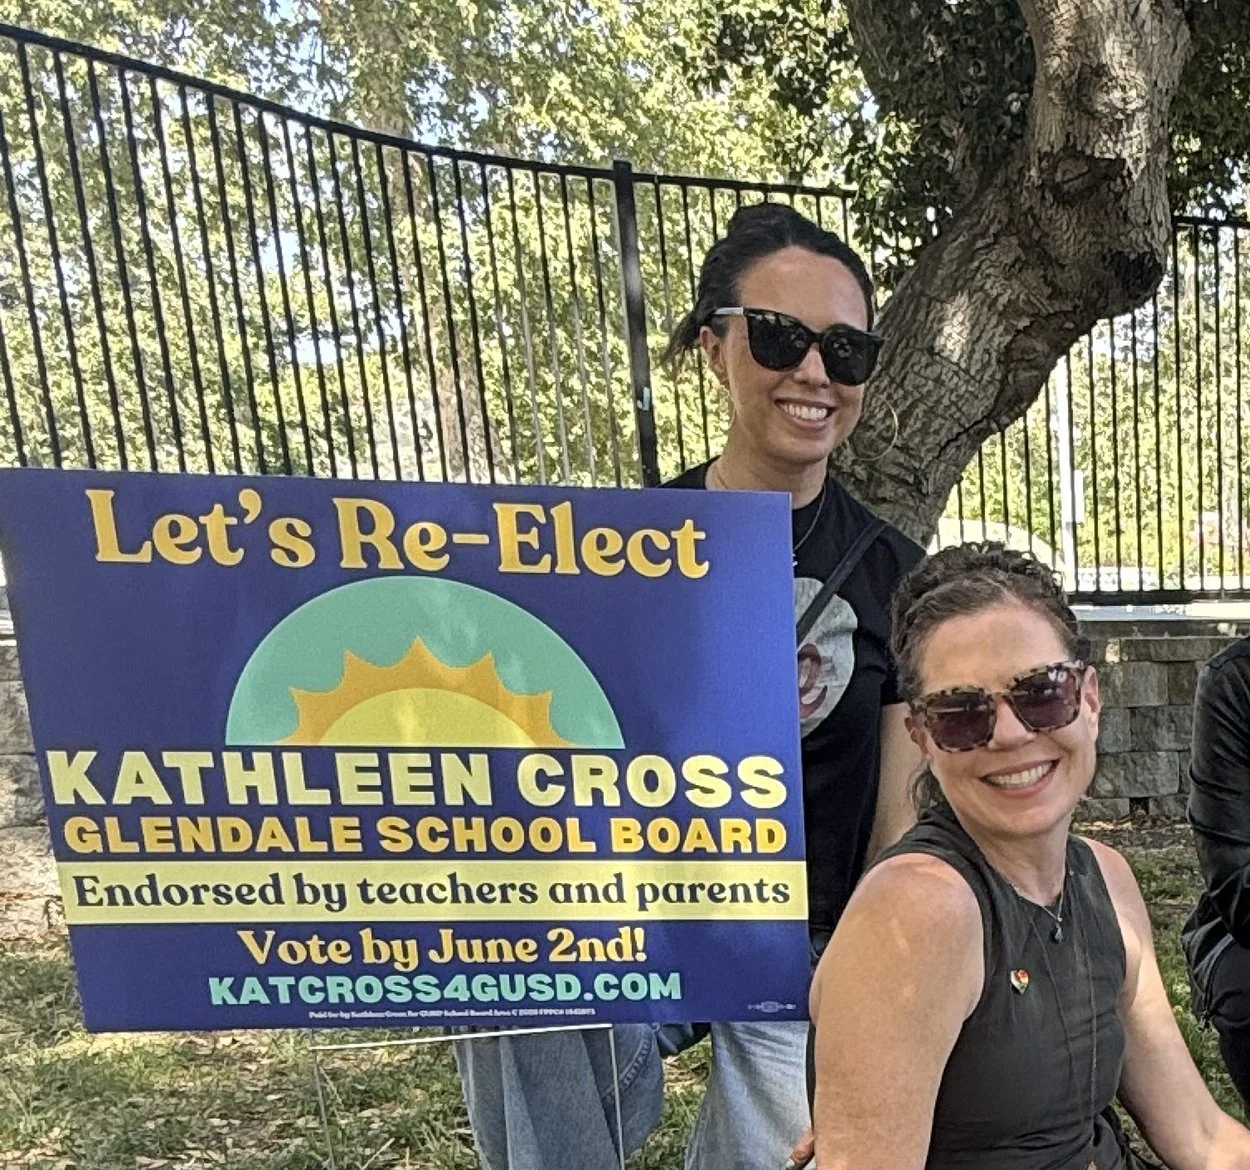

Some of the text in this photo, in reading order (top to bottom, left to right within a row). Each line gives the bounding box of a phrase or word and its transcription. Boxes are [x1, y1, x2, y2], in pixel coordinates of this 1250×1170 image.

[86, 489, 709, 578] Let's Re-Elect
[47, 751, 787, 808] KATHLEEN CROSS
[64, 816, 787, 854] GLENDALE SCHOOL BOARD
[73, 872, 790, 913] Endorsed by teachers and parents
[237, 926, 647, 972] Vote by June 2nd!
[208, 972, 682, 1005] KATCROSS4GUSD.COM
